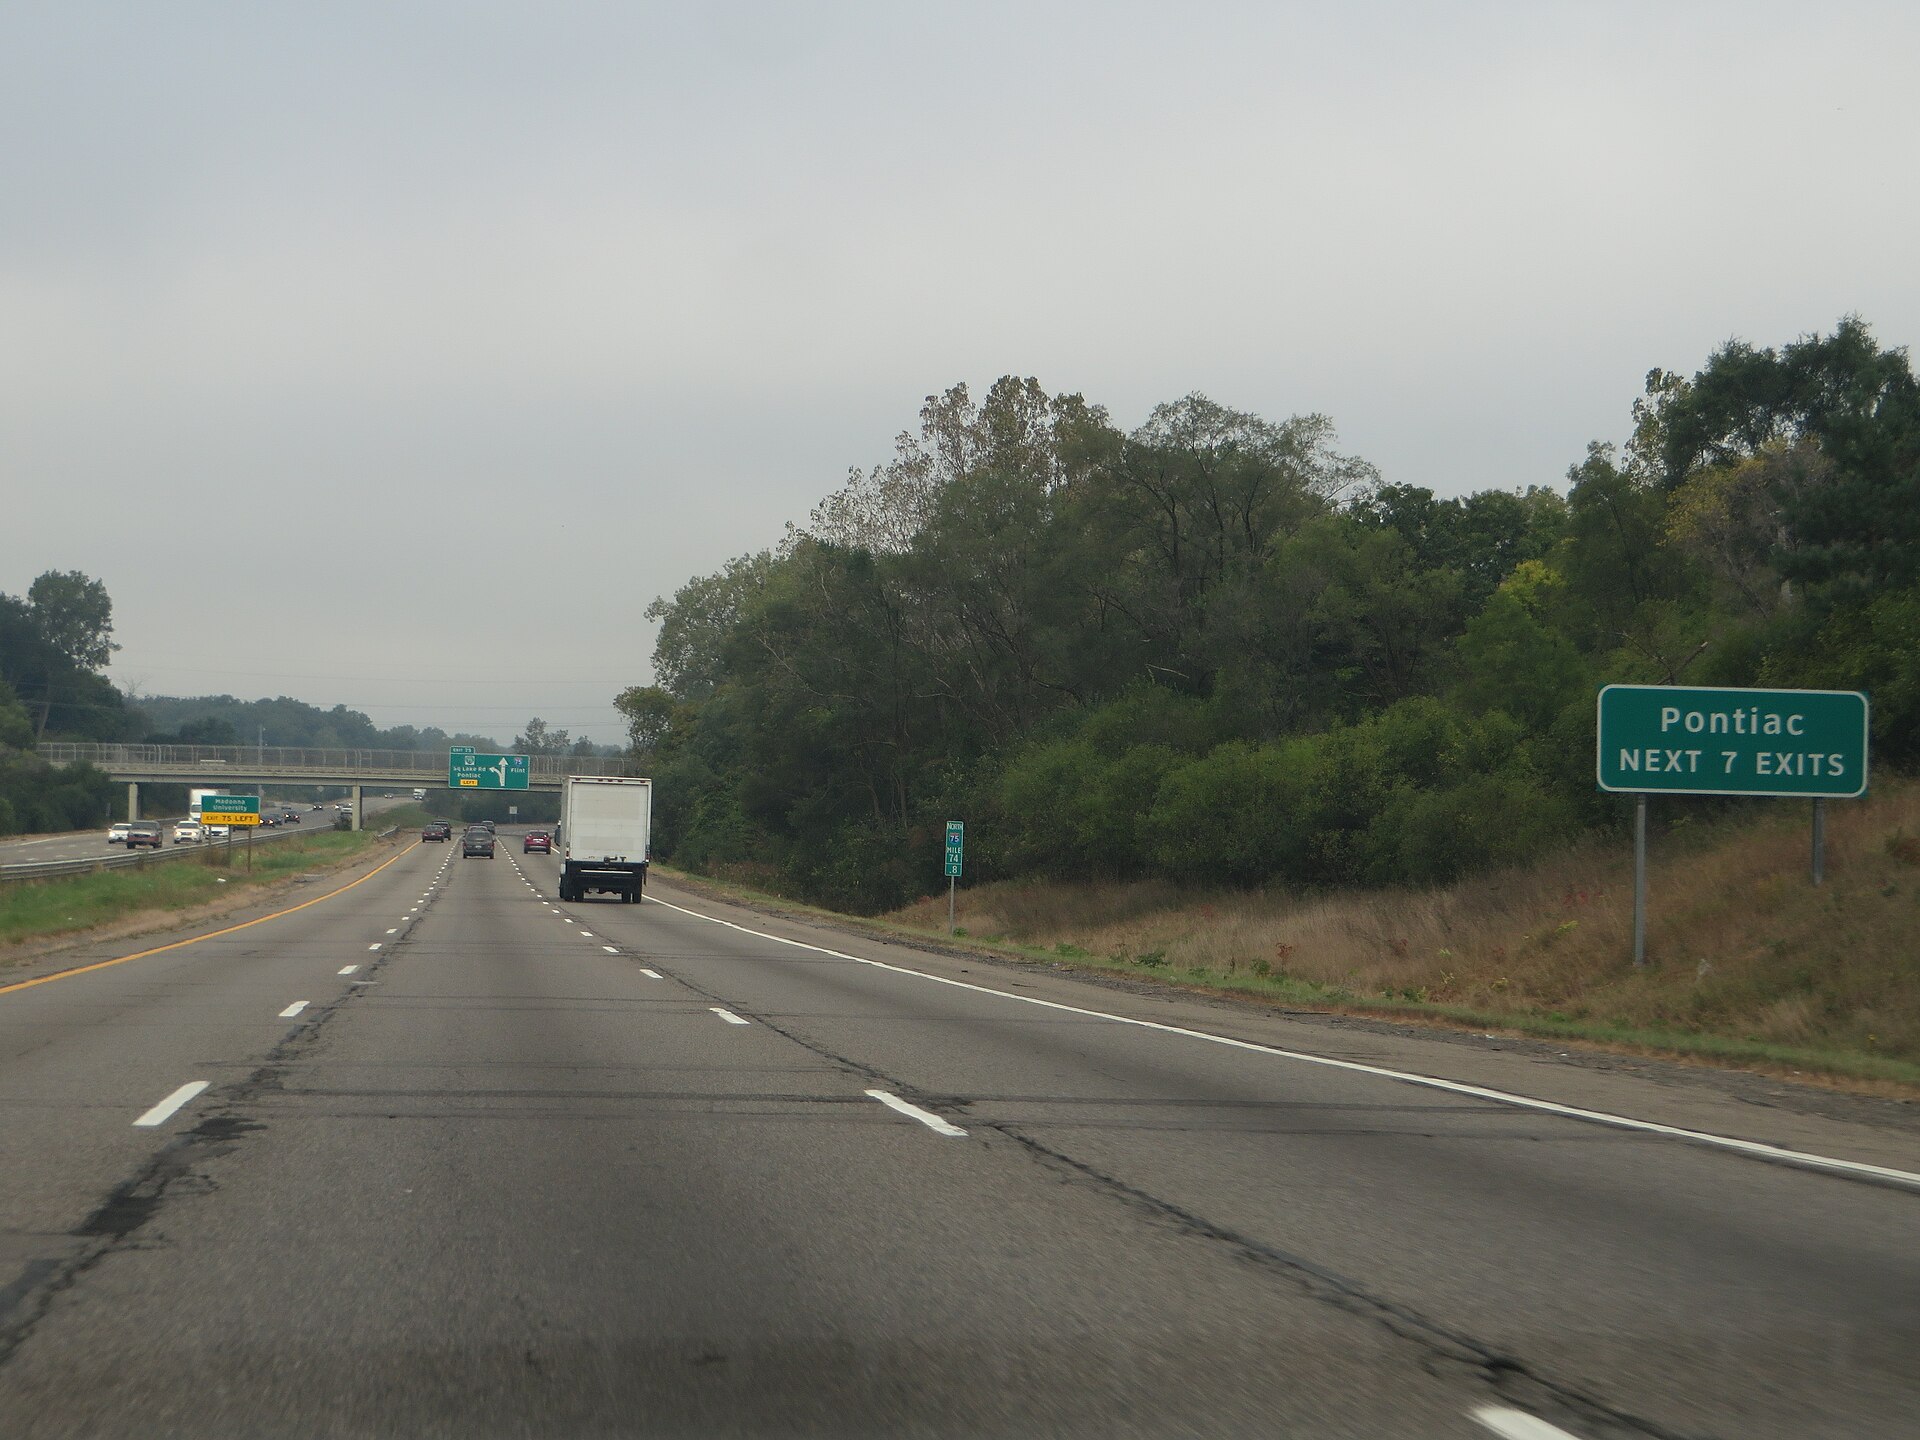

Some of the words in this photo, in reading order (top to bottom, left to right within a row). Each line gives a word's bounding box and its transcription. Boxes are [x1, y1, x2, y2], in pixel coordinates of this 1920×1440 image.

[1660, 706, 1804, 736] Pontiac
[1619, 748, 1702, 773] NEXT
[1720, 751, 1738, 774] 7
[1755, 752, 1845, 777] EXITS
[947, 822, 963, 830] NORTH
[949, 854, 958, 862] 74
